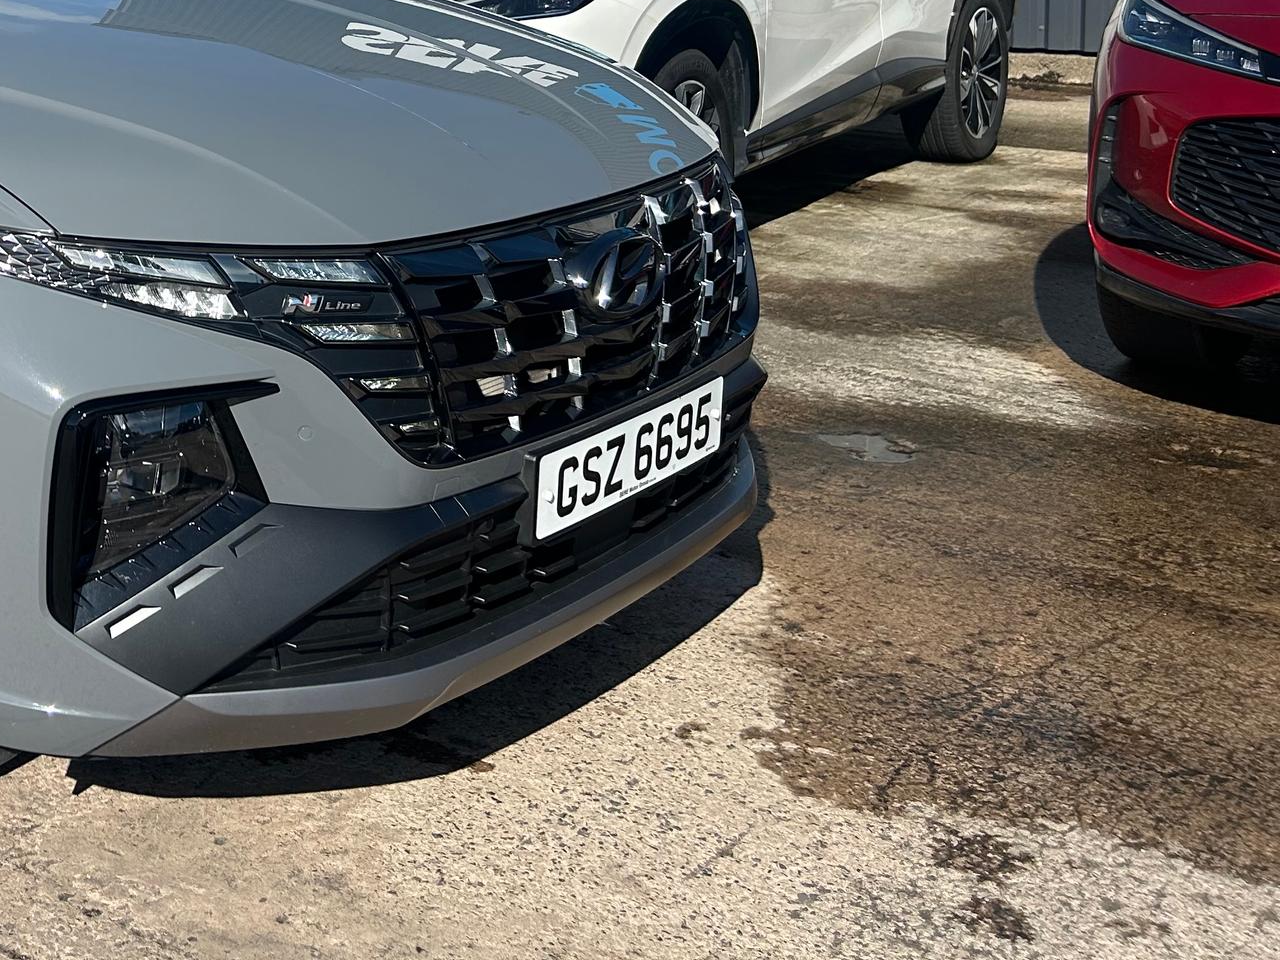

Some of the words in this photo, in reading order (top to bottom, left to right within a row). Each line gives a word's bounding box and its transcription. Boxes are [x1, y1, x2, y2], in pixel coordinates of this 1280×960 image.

[325, 301, 361, 310] Line
[557, 433, 626, 517] GSZ
[634, 392, 712, 480] 6695
